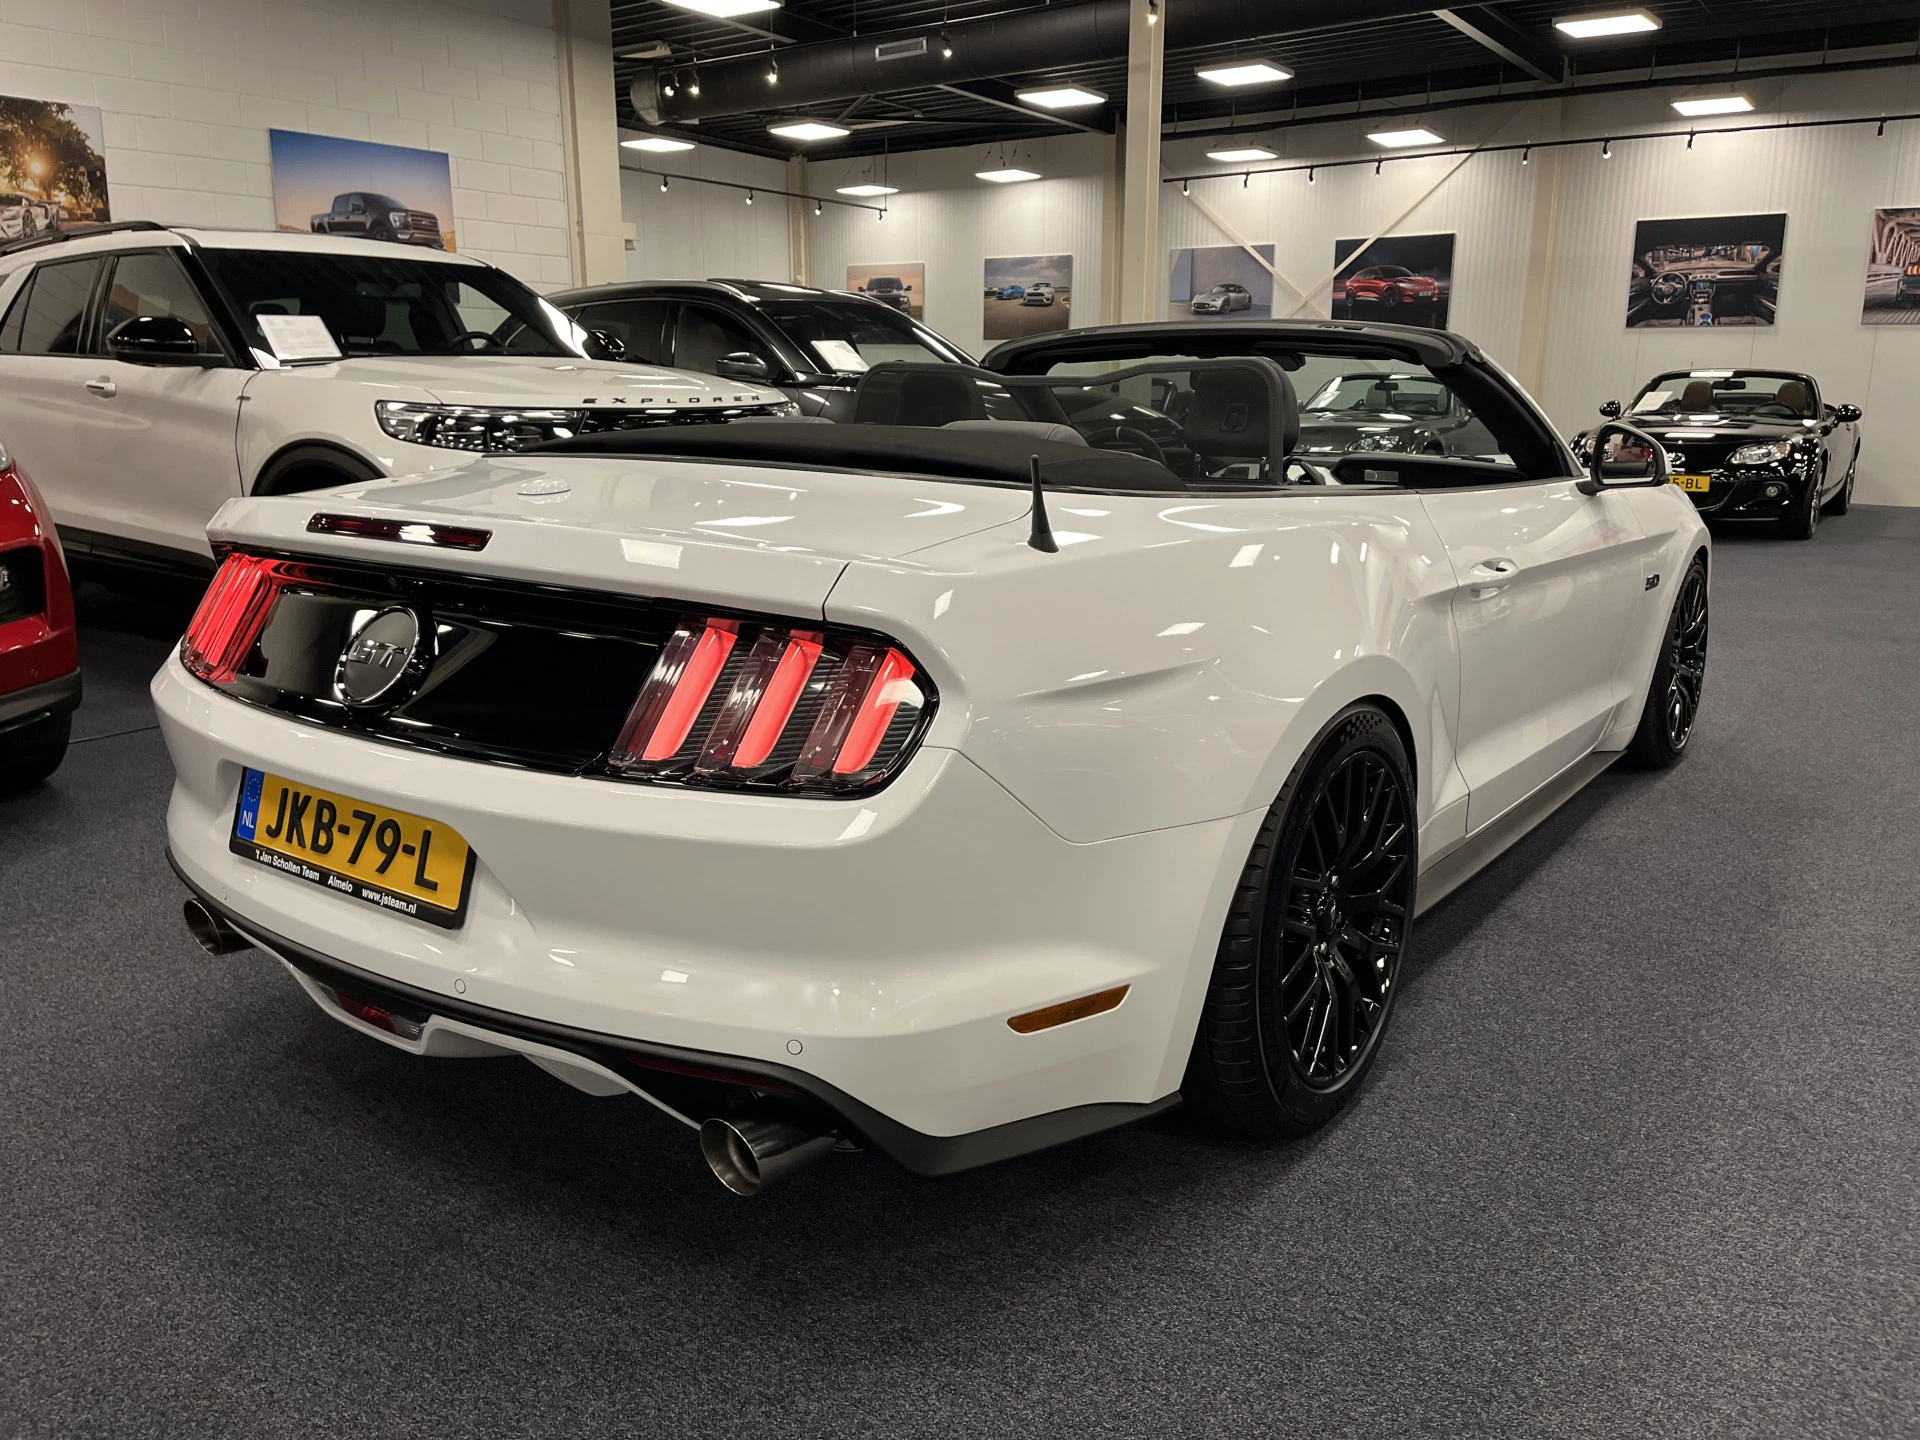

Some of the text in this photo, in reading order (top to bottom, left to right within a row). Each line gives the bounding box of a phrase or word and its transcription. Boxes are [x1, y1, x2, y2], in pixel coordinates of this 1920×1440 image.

[582, 396, 761, 405] EXPLORER
[1669, 477, 1703, 490] 5-BL
[348, 639, 408, 669] GT
[242, 809, 255, 829] NL
[265, 787, 439, 892] JKB-79-L
[260, 851, 272, 864] Jan
[272, 855, 301, 874] Scholten
[301, 865, 320, 881] Team
[327, 874, 353, 893] Almelo
[361, 887, 418, 914] www.jsteam.nl
